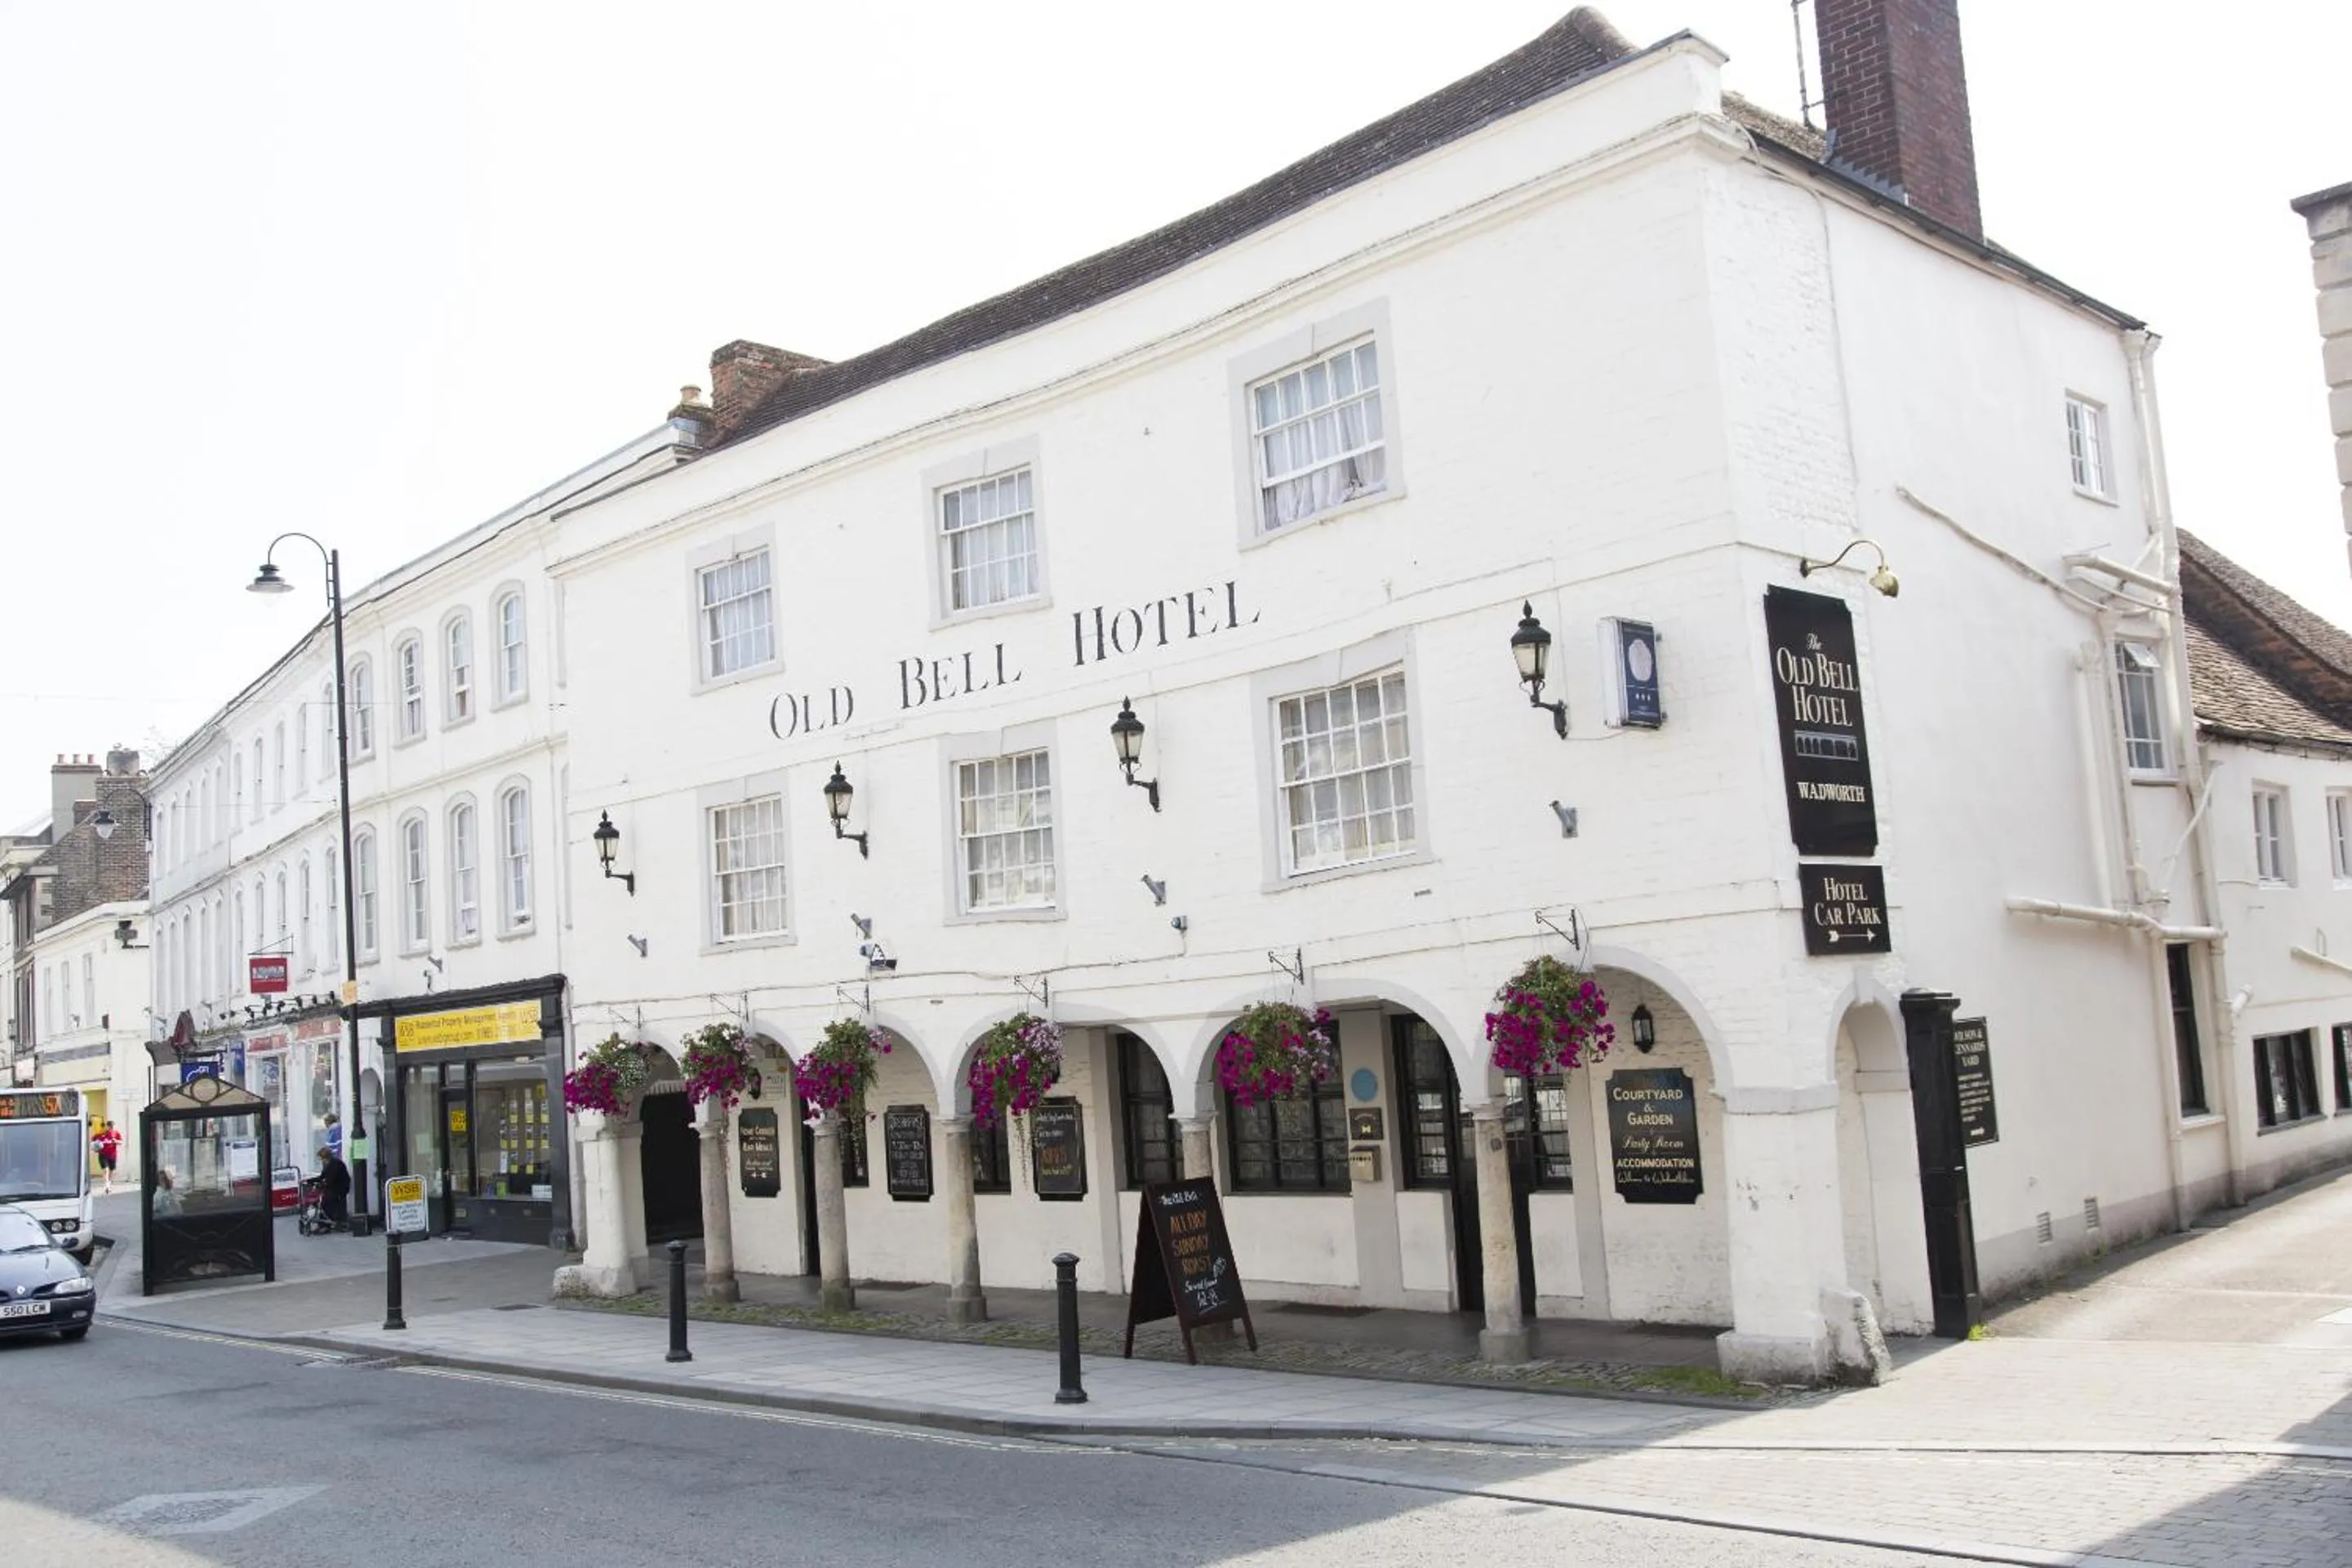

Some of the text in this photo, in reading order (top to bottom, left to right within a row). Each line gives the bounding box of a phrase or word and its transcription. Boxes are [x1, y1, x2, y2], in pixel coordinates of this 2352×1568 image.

[1806, 633, 1824, 651] The
[768, 580, 1260, 740] OLD BELL HOTEL
[1776, 646, 1859, 692] OLD BELL
[1792, 685, 1853, 726] HOTEL
[1796, 781, 1865, 802] WADWORTH
[1823, 877, 1868, 900] HOTEL
[1814, 902, 1881, 926] CAR PARK
[1612, 1087, 1683, 1100] COURTYARD
[1643, 1103, 1654, 1113] &
[1627, 1112, 1674, 1126] GARDEN
[1616, 1157, 1695, 1168] ACCOMMODATION
[394, 1183, 420, 1195] WSB
[1172, 1233, 1209, 1258] SUNDAY
[1182, 1255, 1212, 1275] ROAST
